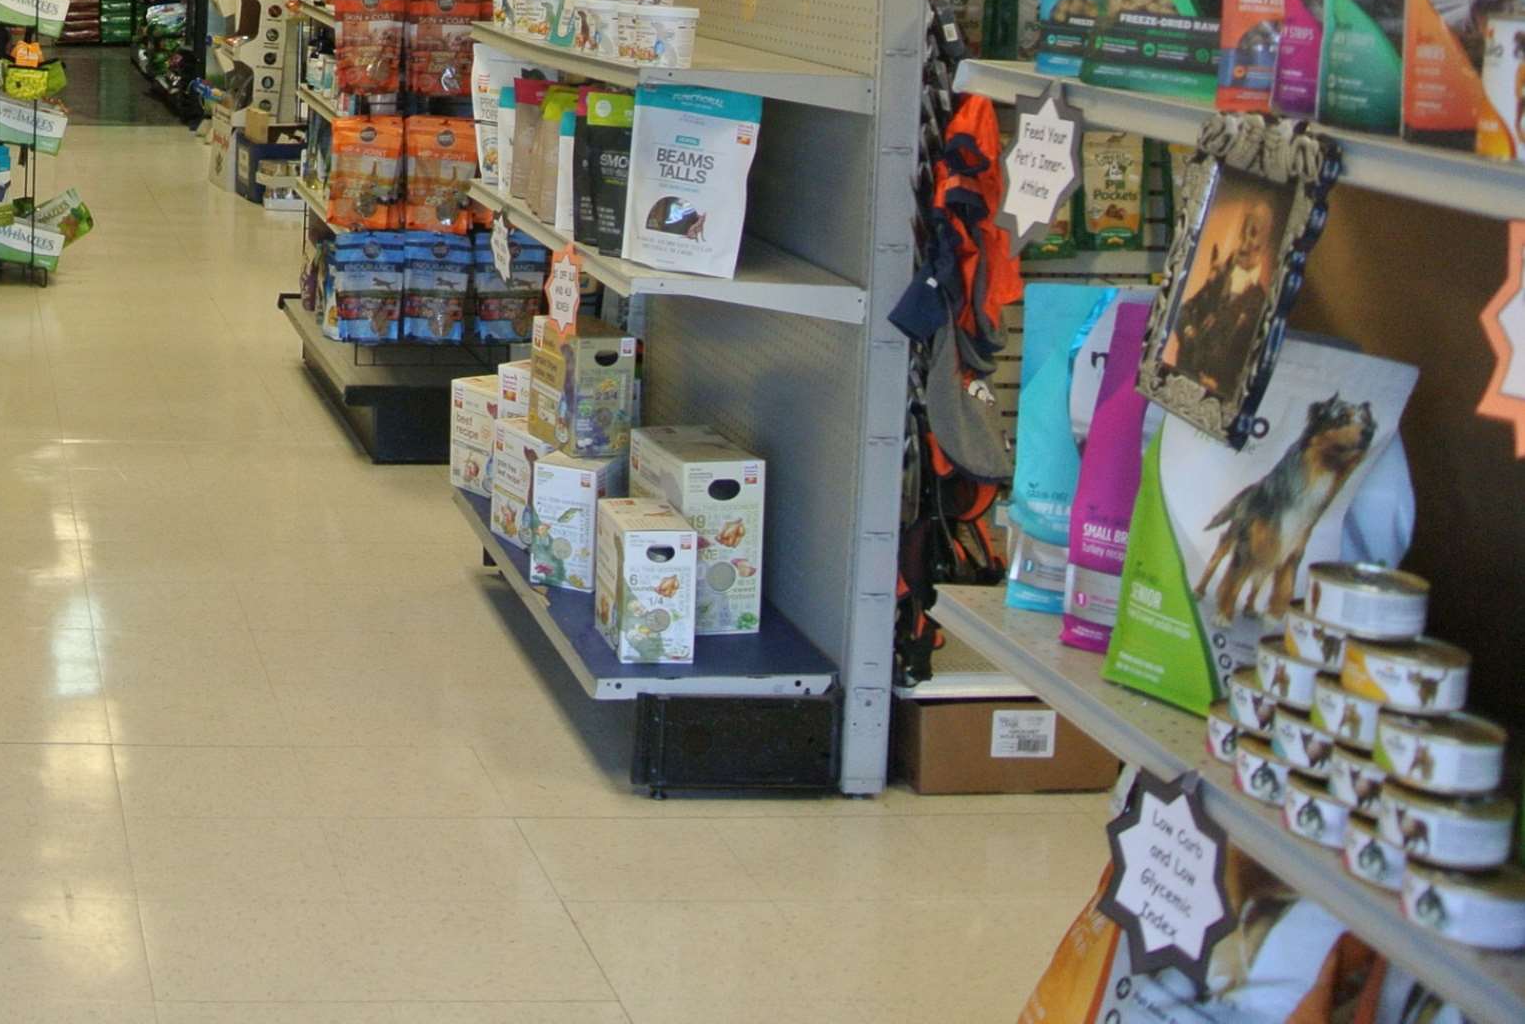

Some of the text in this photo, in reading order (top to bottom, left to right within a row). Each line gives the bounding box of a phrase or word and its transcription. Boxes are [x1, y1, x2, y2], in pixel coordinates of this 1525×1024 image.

[1192, 19, 1221, 34] RAW
[656, 147, 715, 171] BEAMS
[658, 162, 708, 185] TALLS
[1092, 188, 1138, 202] Pockets
[1082, 522, 1113, 542] SMALL
[629, 575, 638, 586] 6
[1152, 809, 1174, 837] Low
[1149, 845, 1196, 887] and Low
[1140, 867, 1193, 919] Glycemic
[1139, 901, 1180, 937] Index
